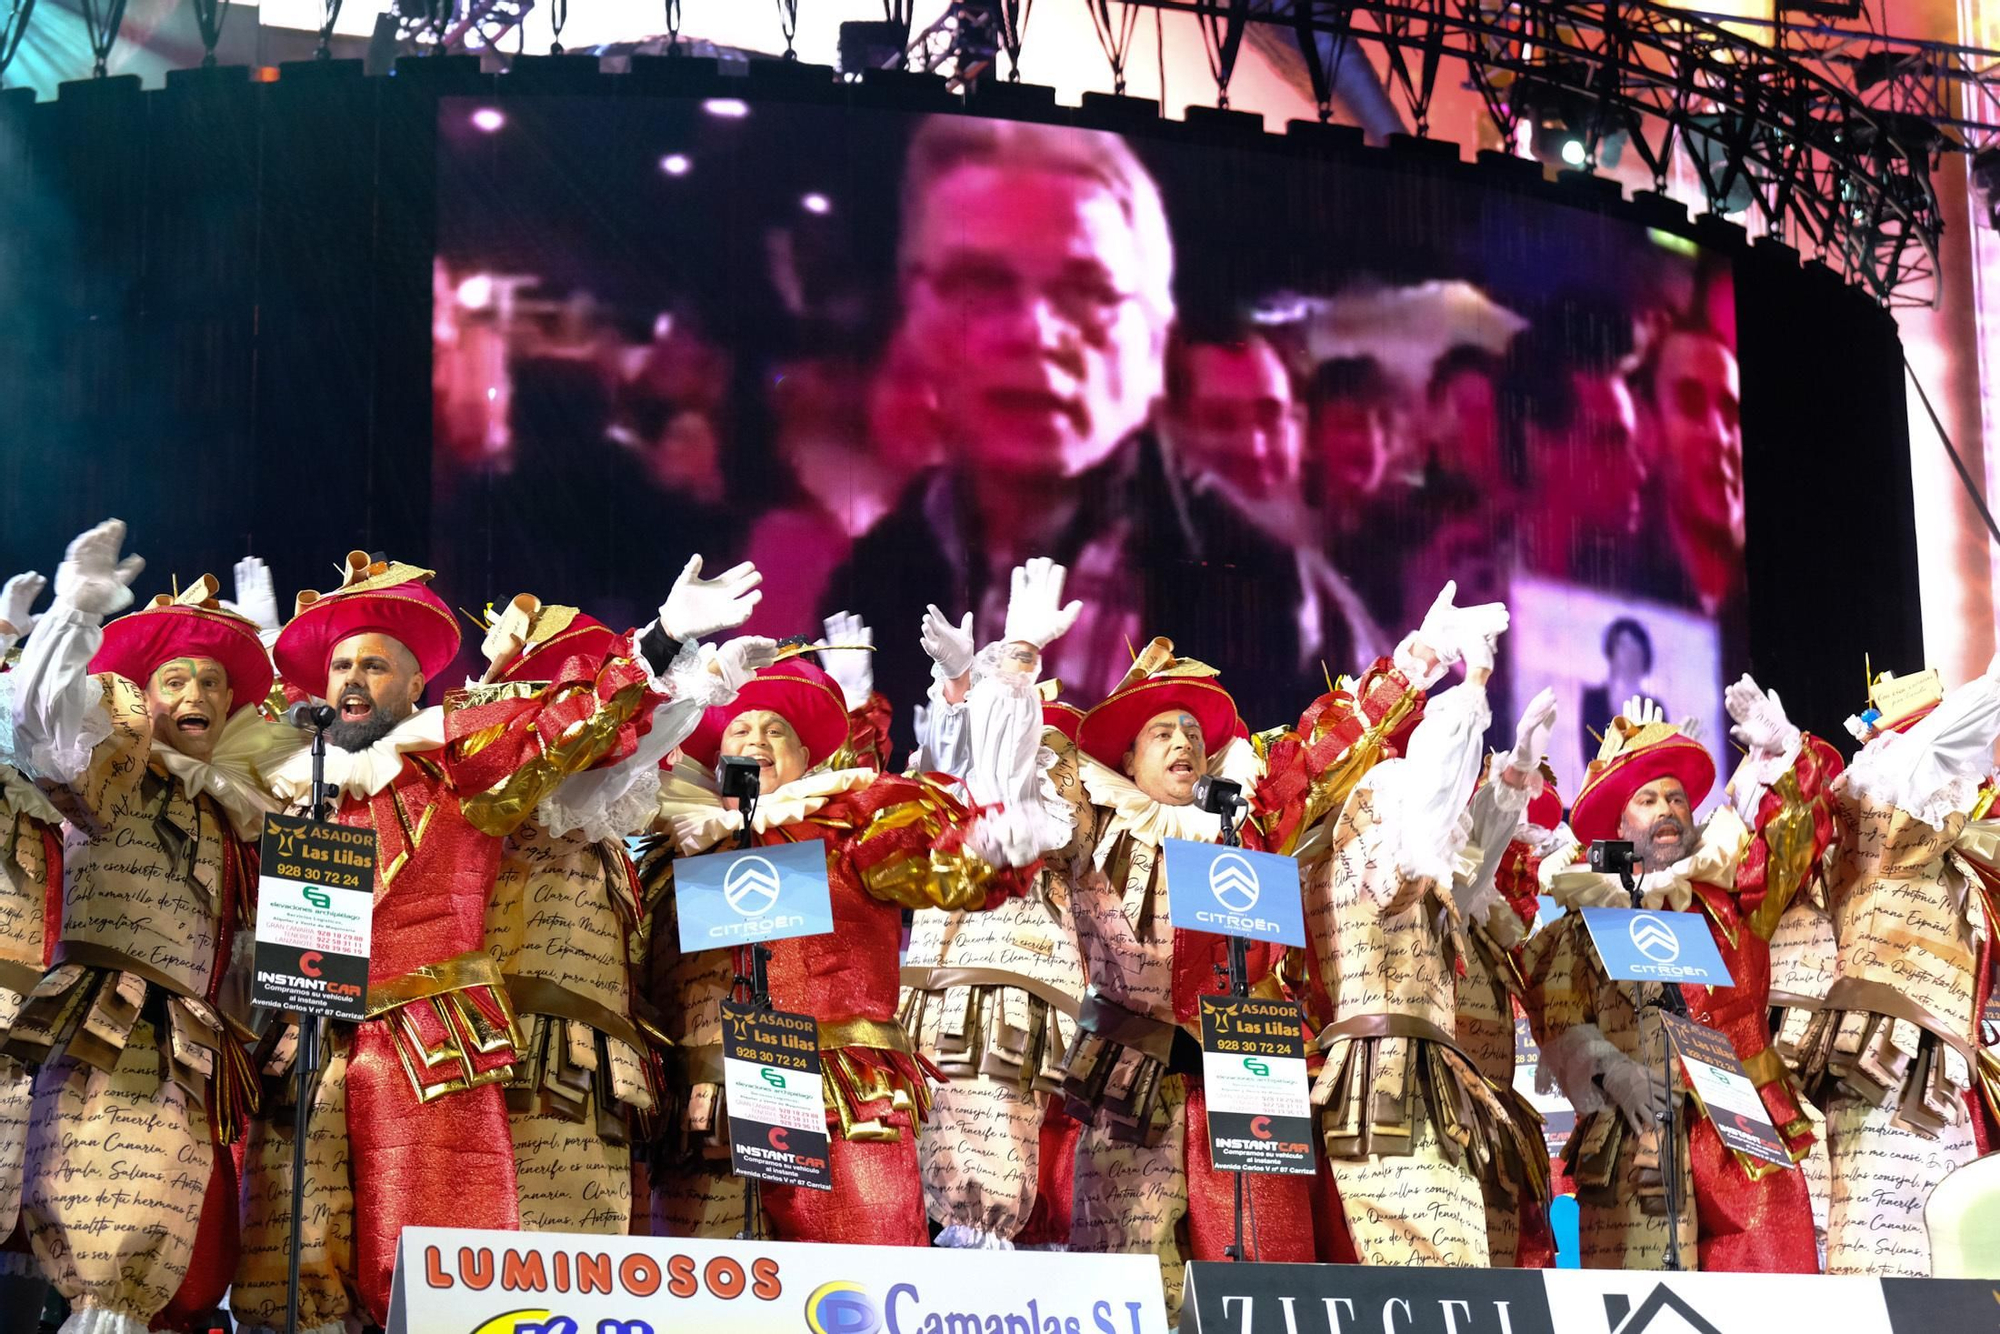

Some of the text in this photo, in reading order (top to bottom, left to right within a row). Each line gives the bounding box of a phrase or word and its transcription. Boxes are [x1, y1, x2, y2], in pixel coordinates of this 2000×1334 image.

[310, 825, 373, 847] ASADOR
[301, 844, 372, 868] Las Lilas
[276, 863, 359, 886] 928 30 72 24
[533, 884, 573, 903] Clara
[1891, 883, 1938, 906] Antonio
[264, 983, 309, 996] Compramos
[252, 998, 281, 1008] Avenida
[283, 1002, 307, 1012] Carlos
[335, 1010, 363, 1020] Carrizal
[297, 996, 327, 1006] instante
[1241, 1003, 1297, 1016] ASADOR
[758, 1012, 813, 1032] ASADOR
[1236, 1020, 1300, 1036] Las Lilas
[753, 1029, 815, 1051] Las Lilas
[1217, 1039, 1291, 1053] 928 30 72 24
[735, 1046, 806, 1068] 928 30 72 24
[104, 1105, 165, 1132] Tenerife
[956, 1120, 999, 1142] Tenerife
[61, 1133, 101, 1155] Gran
[1222, 1148, 1264, 1156] Compramos
[54, 1159, 167, 1183] Ayala, Salinas,
[514, 1157, 568, 1180] Tenerife
[743, 1155, 782, 1167] Compramos
[773, 1167, 798, 1177] instante
[735, 1168, 760, 1178] Avenida
[761, 1172, 782, 1181] Carlos
[806, 1181, 831, 1190] Carrizal
[582, 1180, 618, 1201] Clara
[1872, 1188, 1923, 1215] Tenerife
[133, 1190, 186, 1215] hermano
[522, 1210, 575, 1228] Salinas,
[1874, 1238, 1924, 1257] Salinas,
[424, 1244, 782, 1302] LUMINOSOS
